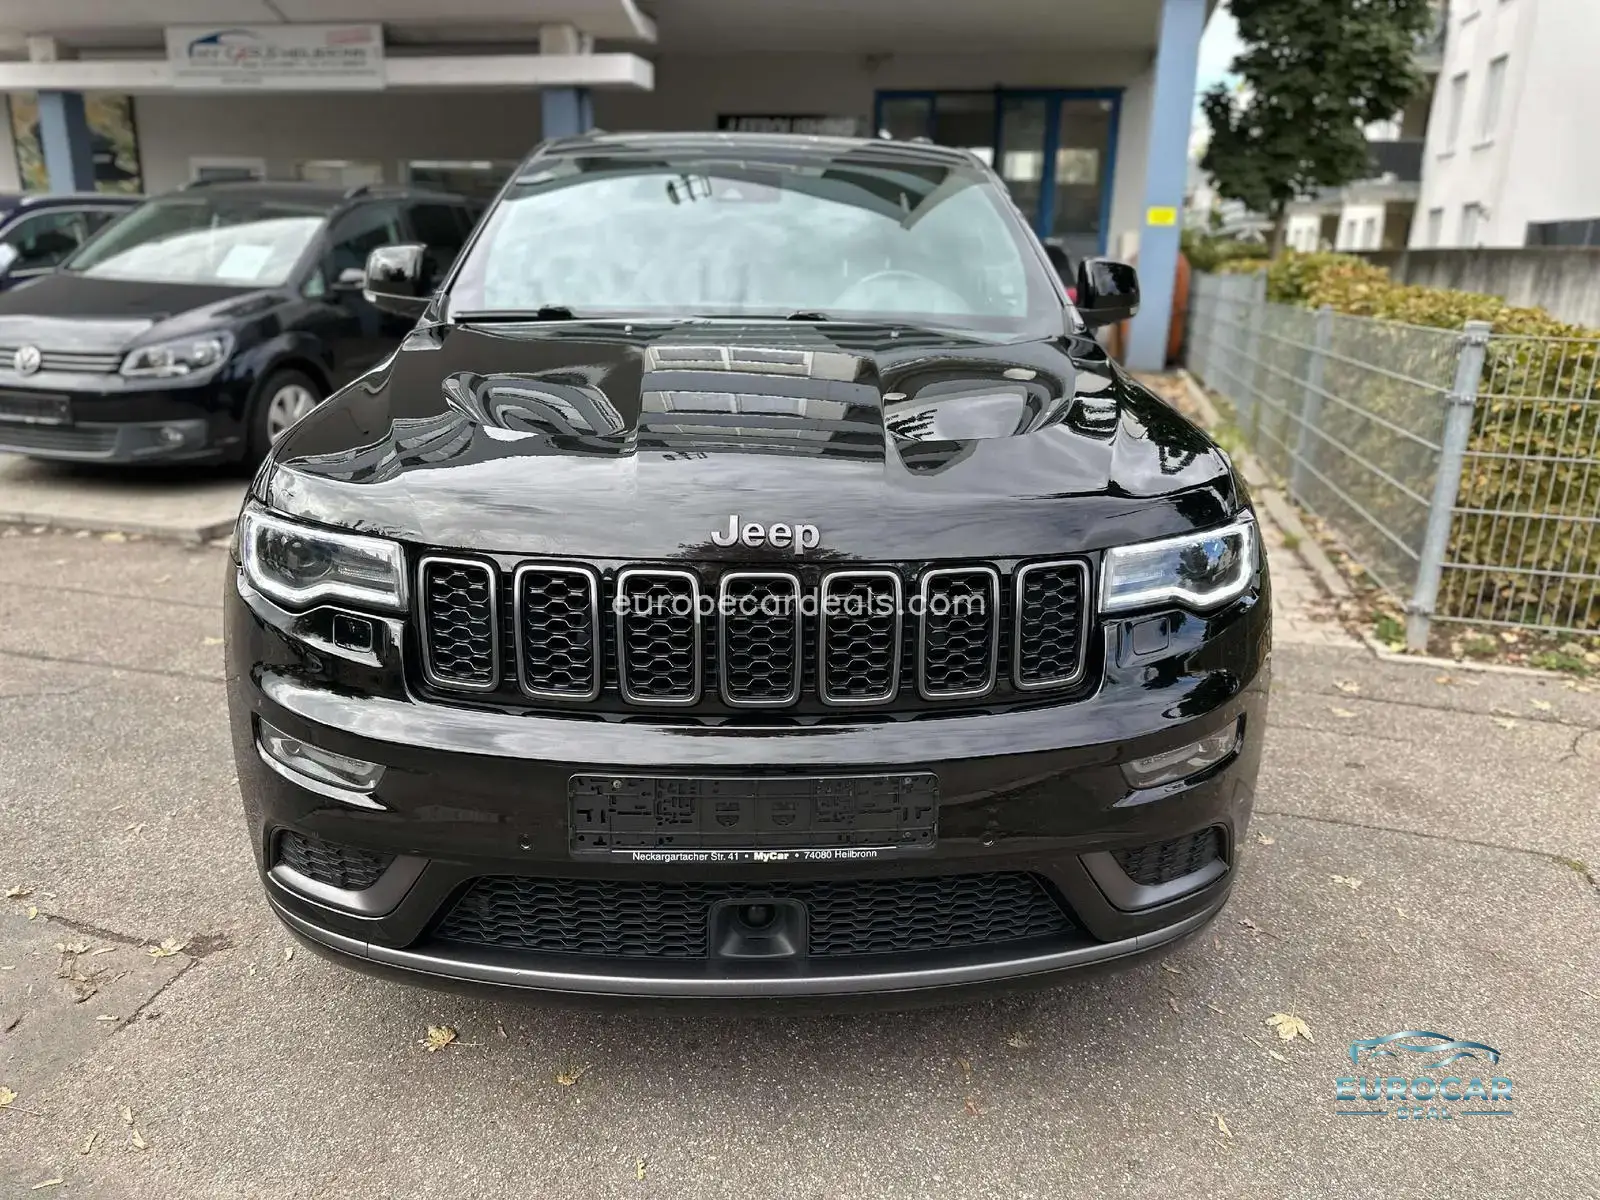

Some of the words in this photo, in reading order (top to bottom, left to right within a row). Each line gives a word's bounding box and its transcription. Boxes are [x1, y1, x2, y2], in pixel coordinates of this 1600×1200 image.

[711, 514, 821, 555] Jeep
[632, 851, 708, 862] Neckargartacher
[711, 852, 726, 861] Str.
[728, 852, 739, 861] 41
[753, 852, 789, 862] MyCar
[804, 851, 832, 859] 74080
[834, 850, 877, 859] Heilbronn
